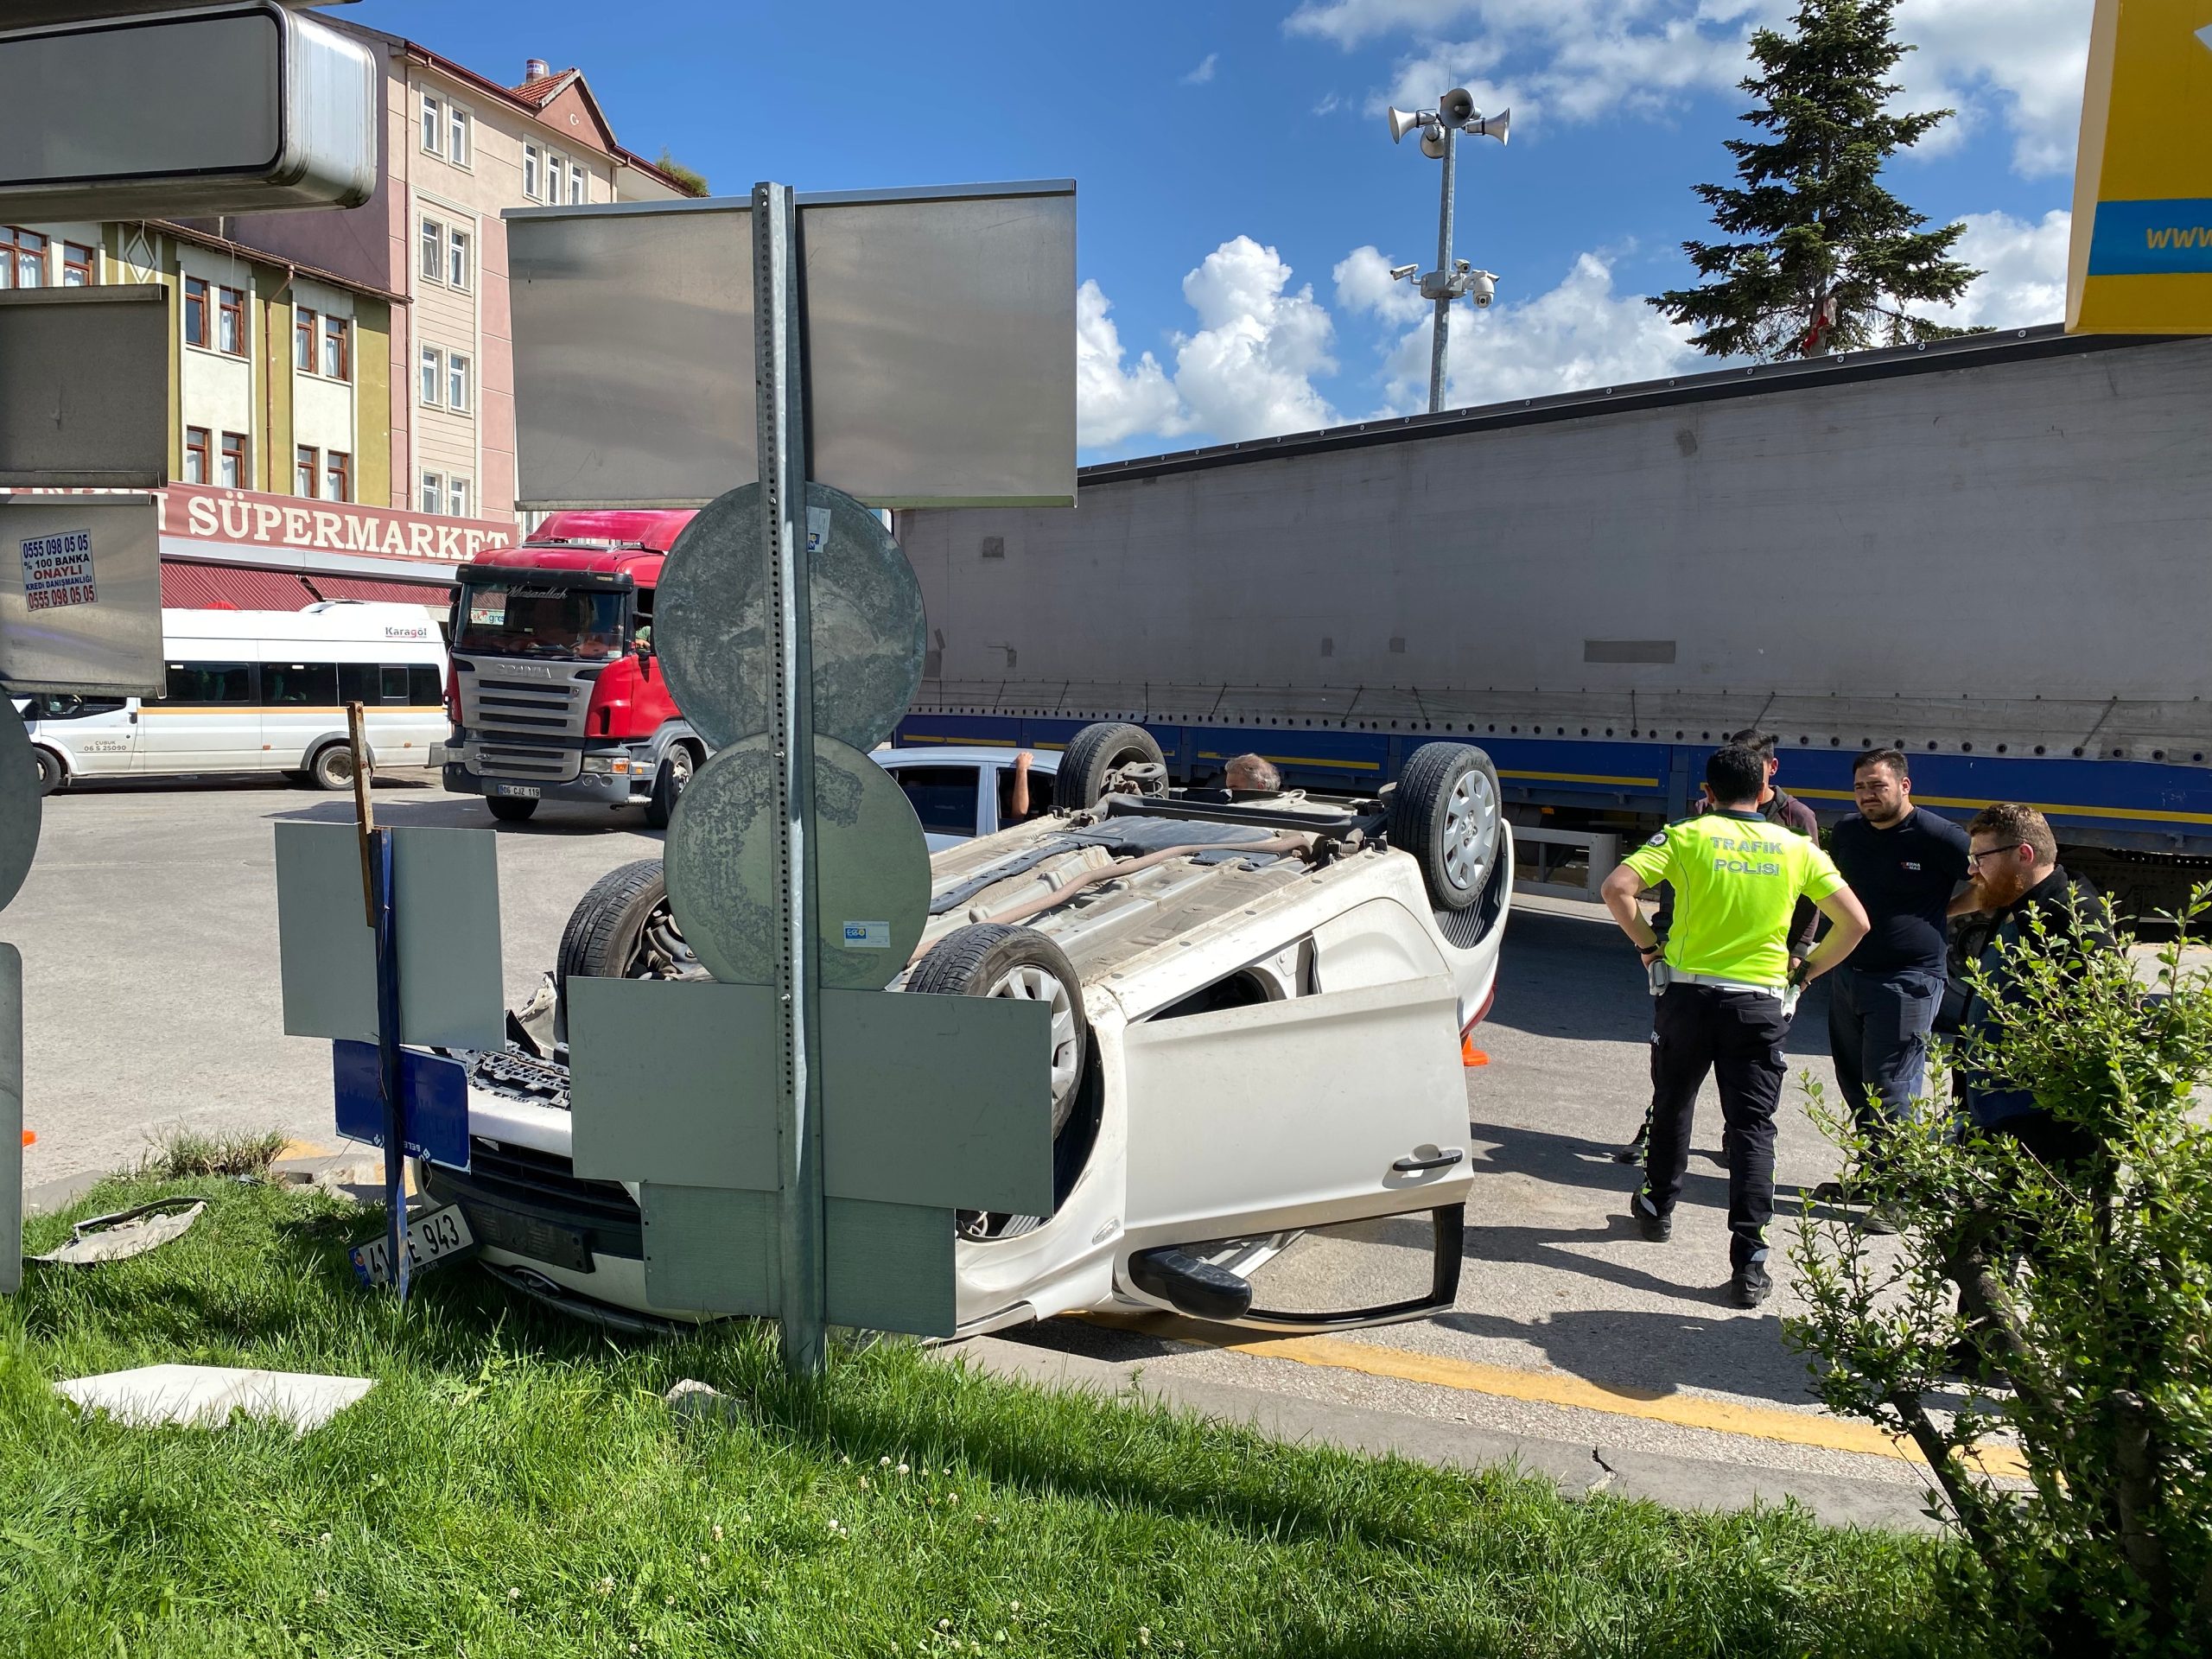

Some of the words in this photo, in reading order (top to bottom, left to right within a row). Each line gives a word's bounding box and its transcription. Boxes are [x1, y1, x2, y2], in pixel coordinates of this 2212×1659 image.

[187, 490, 510, 562] SÜPERMARKET
[22, 540, 44, 559] 0555
[46, 537, 62, 556] 098
[65, 536, 75, 553] 05
[77, 534, 88, 551] 05
[24, 561, 33, 570] %
[35, 558, 52, 569] 100
[54, 553, 90, 566] BANKA
[33, 564, 83, 581] ONAYLI
[46, 575, 92, 588] DANIŞMANLIĞI
[28, 590, 50, 609] 0555
[51, 588, 68, 606] 098
[70, 586, 81, 603] 05
[83, 584, 95, 602] 05
[385, 626, 428, 639] Karagöl
[498, 664, 552, 679] SCANIA
[513, 787, 524, 796] CJZ
[529, 788, 540, 797] 119
[370, 1243, 390, 1276] 41
[422, 1214, 460, 1255] 943
